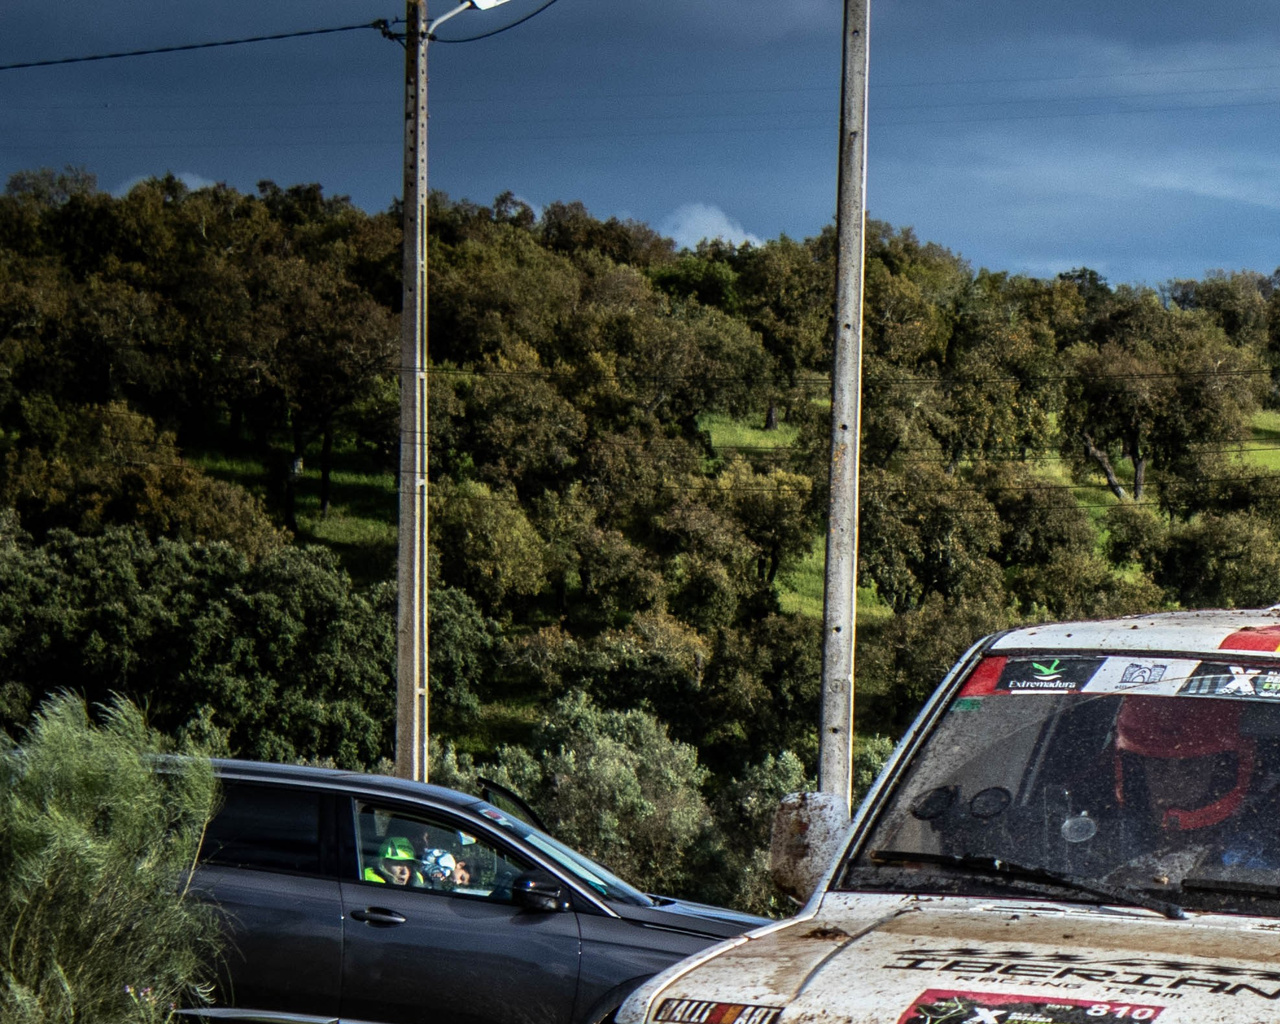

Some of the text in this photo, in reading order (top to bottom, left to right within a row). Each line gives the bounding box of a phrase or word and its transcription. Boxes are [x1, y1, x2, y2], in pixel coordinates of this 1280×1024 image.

[1008, 679, 1077, 689] Extremadura
[954, 975, 1184, 999] RACING TEAM
[1086, 1003, 1155, 1021] 810
